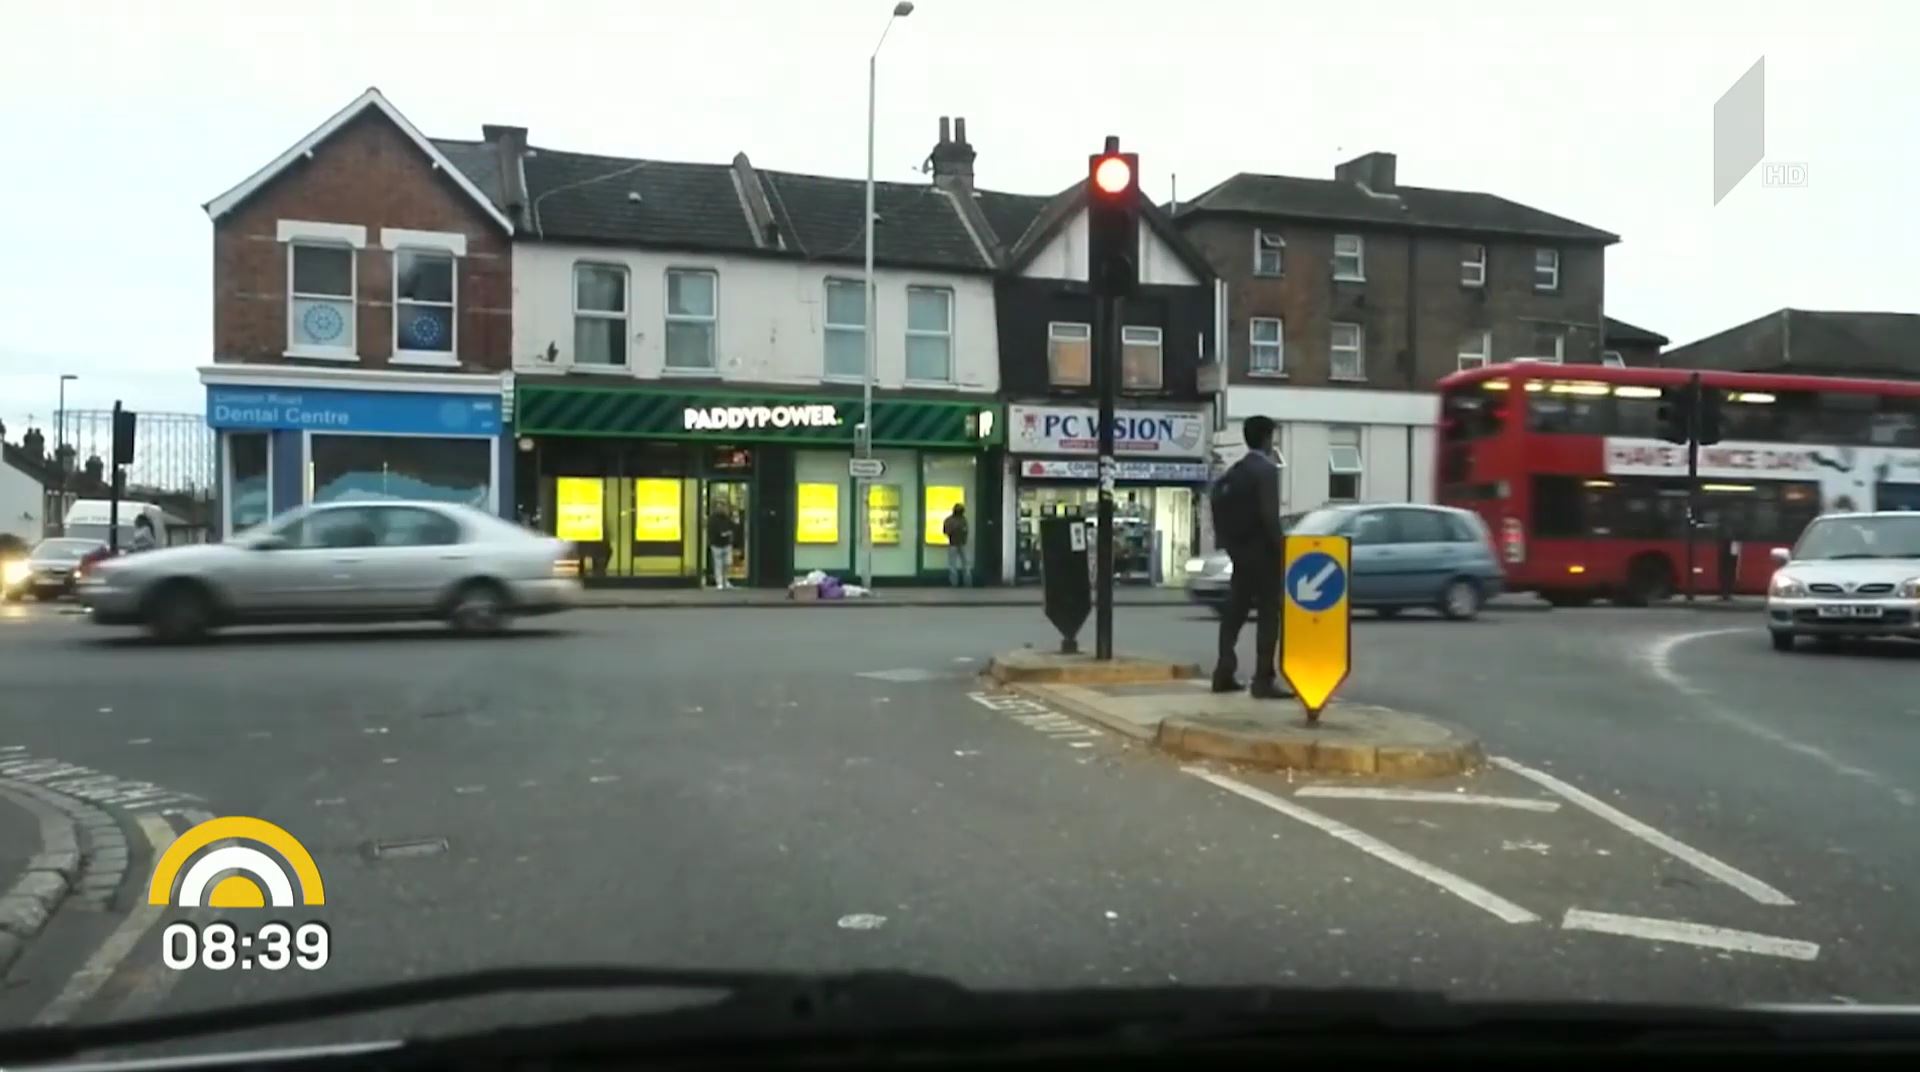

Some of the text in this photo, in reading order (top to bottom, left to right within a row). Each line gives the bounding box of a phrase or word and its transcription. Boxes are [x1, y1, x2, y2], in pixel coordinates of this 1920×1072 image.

[215, 405, 349, 425] Dental Centre
[1044, 415, 1173, 441] PC VSION
